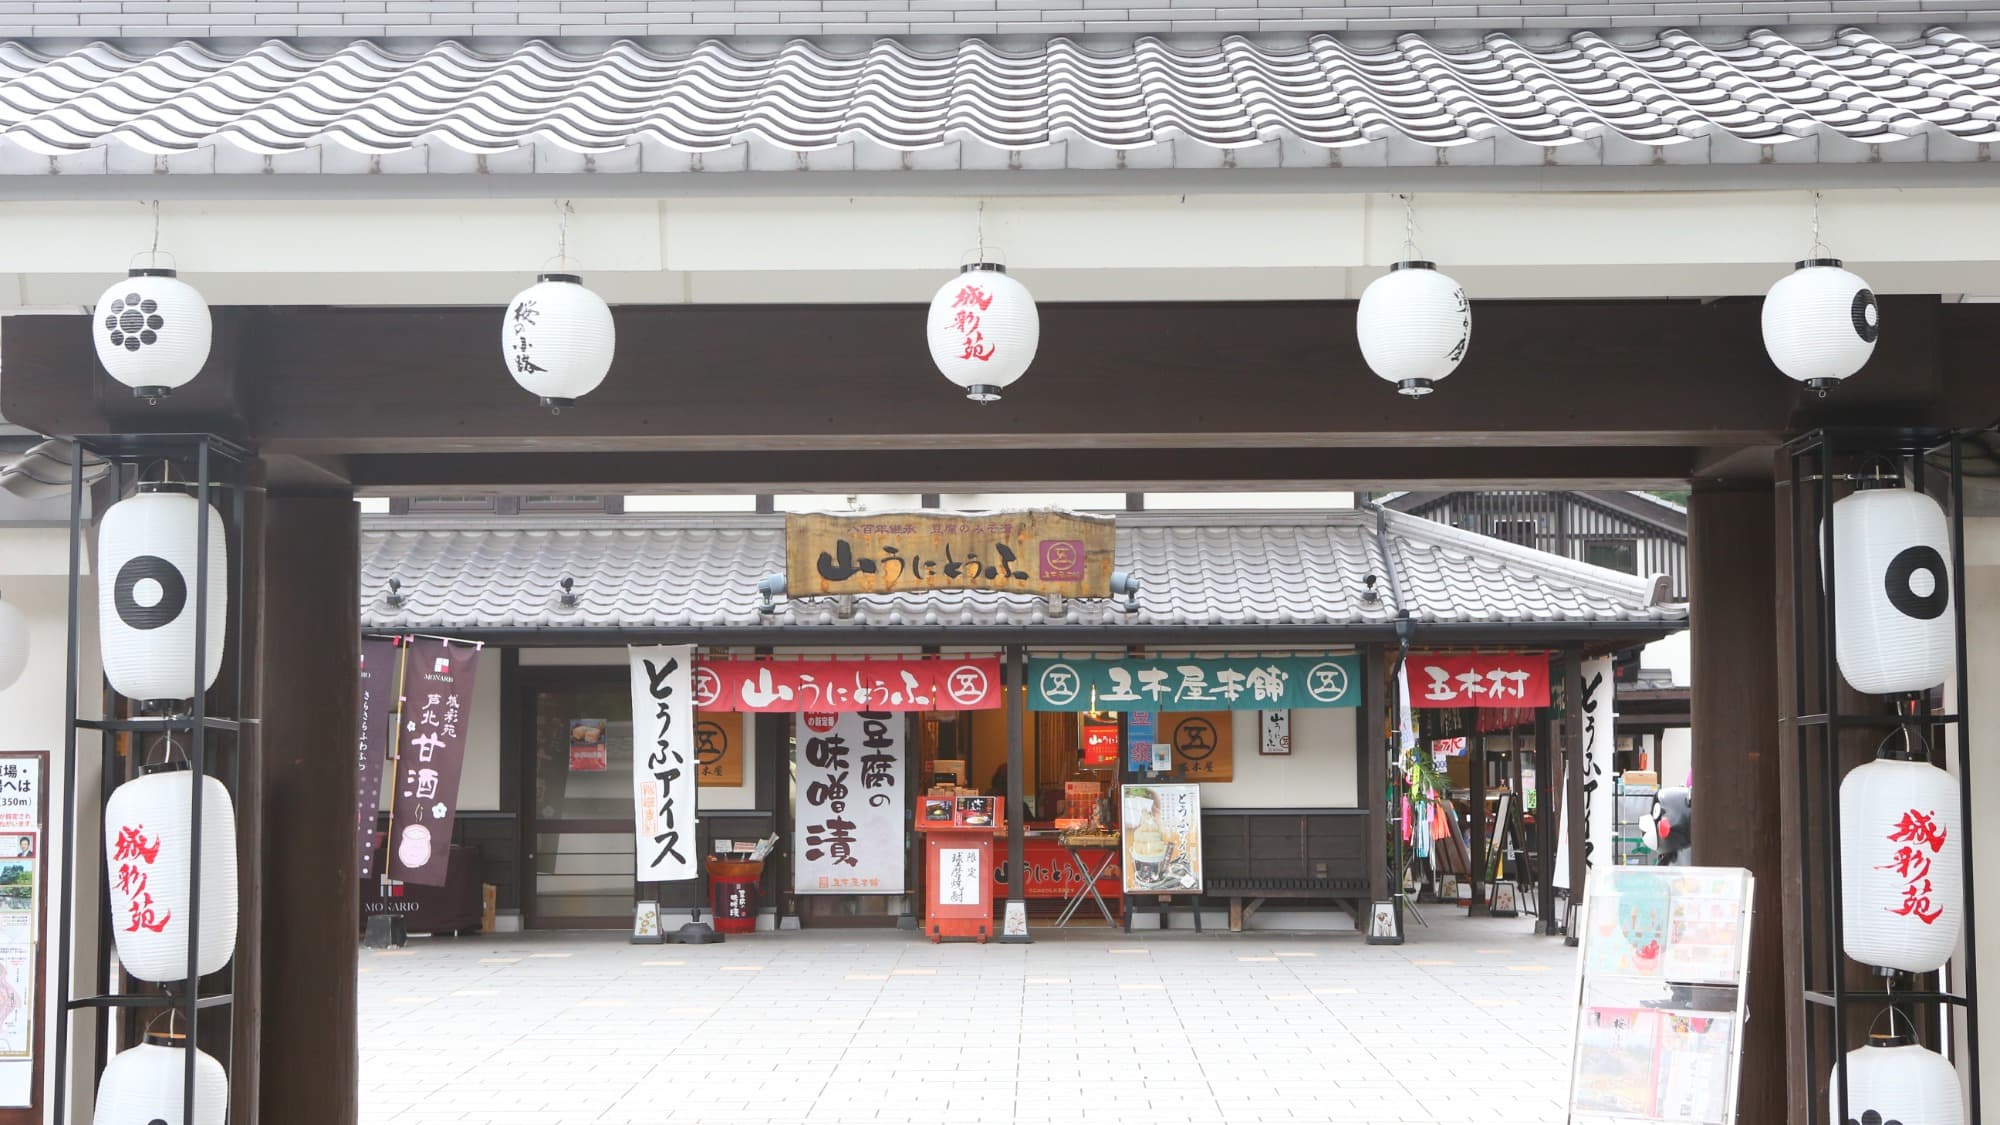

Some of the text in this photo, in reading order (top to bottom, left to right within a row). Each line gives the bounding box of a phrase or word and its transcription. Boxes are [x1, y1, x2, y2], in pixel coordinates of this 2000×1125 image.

[513, 300, 548, 374] 桜の小路
[944, 284, 995, 362] 城彩苑
[817, 539, 1029, 587] 山うにとうふ
[421, 693, 441, 727] 芦北
[741, 667, 930, 708] 山うにとうふ
[1100, 665, 1289, 703] 五木屋本舗
[1424, 666, 1530, 700] 五木村
[0, 764, 27, 778] 場・
[0, 780, 31, 793] へは
[403, 732, 446, 800] 甘酒
[643, 657, 687, 868] とうふアイス
[856, 711, 899, 808] 豆腐の
[0, 797, 32, 808] 350m)
[805, 734, 859, 868] 味噌漬
[113, 823, 171, 933] 城彩苑
[1873, 808, 1947, 925] 城彩苑
